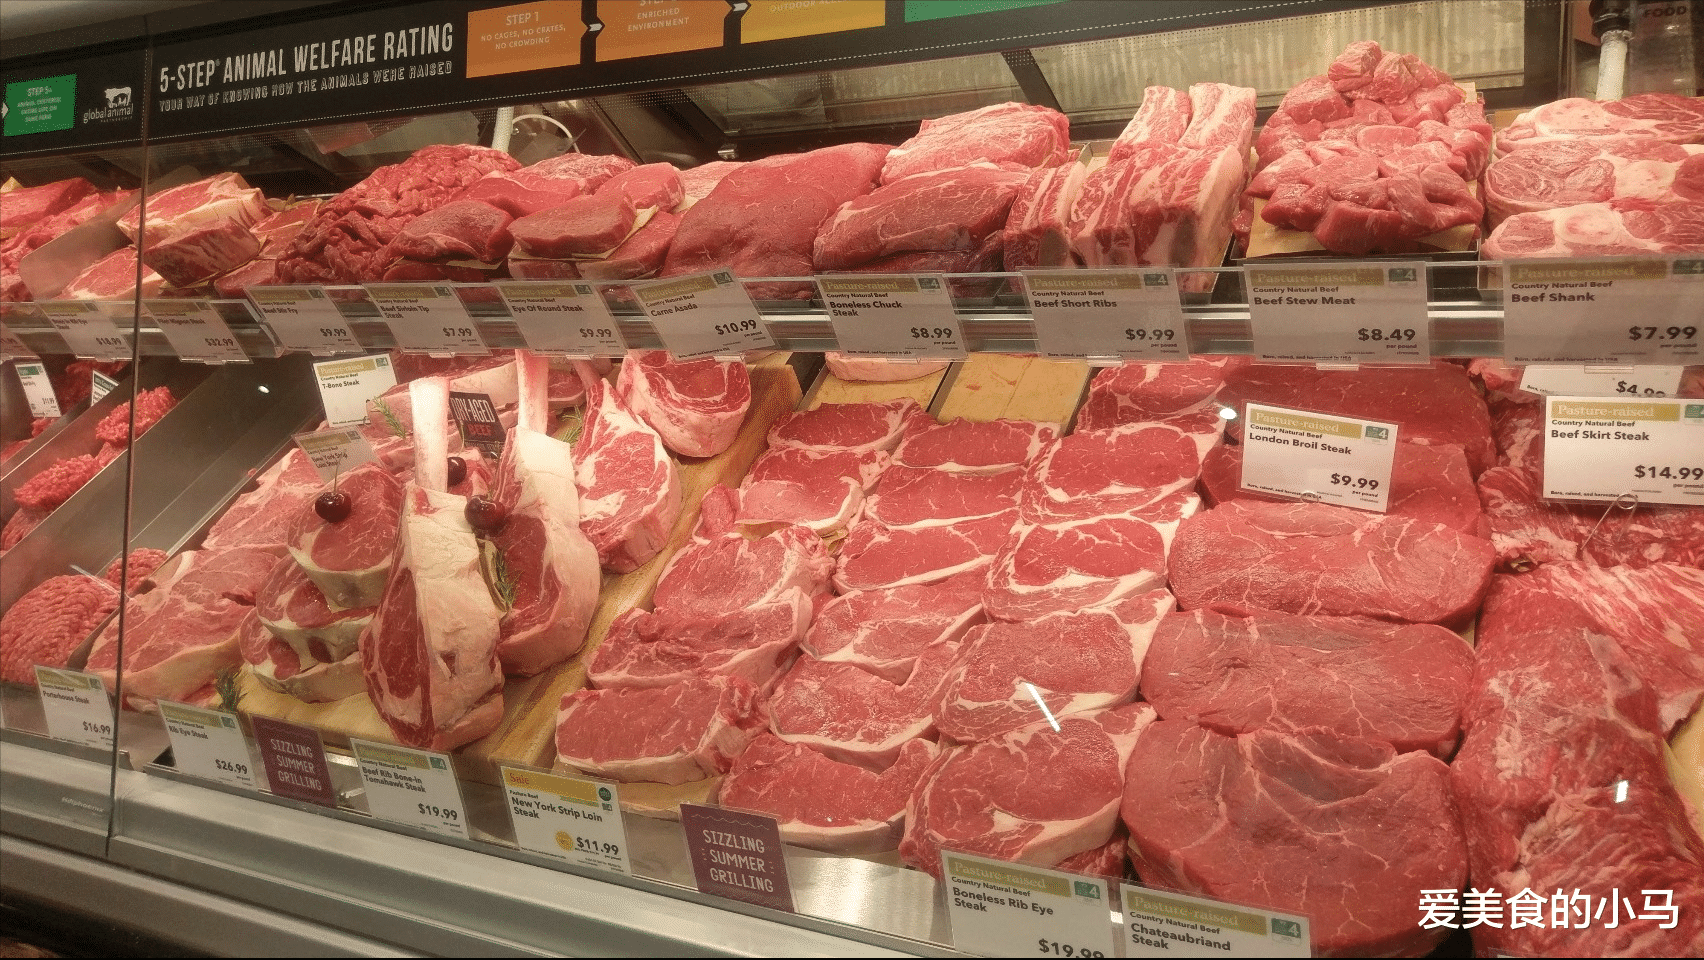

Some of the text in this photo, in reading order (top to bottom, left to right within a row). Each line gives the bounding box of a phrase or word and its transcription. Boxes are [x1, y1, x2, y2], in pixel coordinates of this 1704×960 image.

[506, 11, 539, 26] STEP 1
[637, 7, 680, 20] ENRICHED
[627, 16, 690, 32] ENVIRONMENT
[481, 24, 566, 42] NO CAGES, NO CRATES,
[495, 36, 550, 50] NO CROWDING
[223, 48, 287, 84] ANIMAL
[294, 33, 377, 73] WELFARE
[383, 22, 454, 61] RATING
[159, 60, 453, 112] YOUR WAY OF KNOWING HOW THE ANIMALS WERE RAISED
[83, 103, 134, 124] global animal
[1257, 272, 1357, 284] Pasture-raised
[1518, 267, 1635, 279] Pasture-raised
[826, 281, 900, 290] Pasture-raised
[1032, 278, 1118, 288] Pasture-raised
[1253, 286, 1285, 294] Country
[1511, 282, 1549, 290] Country
[1551, 281, 1588, 289] Natural
[1032, 290, 1060, 298] Country
[1254, 296, 1356, 305] Beef Stew Meat
[1511, 292, 1595, 303] Beef Shank
[512, 305, 525, 314] Eye
[650, 302, 698, 317] Carne Asada
[829, 300, 903, 309] Boneless Chuck
[1034, 299, 1118, 308] Beef Short Ribs
[832, 309, 859, 317] Steak
[320, 328, 347, 337] $9.99
[443, 327, 472, 337] $7.99
[579, 328, 612, 338] $9.99
[715, 319, 757, 336] $10.99
[910, 326, 953, 339] $8.99
[1125, 328, 1175, 341] $9.99
[1357, 327, 1416, 342] $8.49
[1628, 325, 1697, 341] $7.99
[204, 338, 234, 347] $32.99
[450, 397, 496, 423] DRY-AGED
[1558, 404, 1655, 417] Pasture-raised
[467, 423, 492, 436] BEEF
[1255, 412, 1339, 433] Pasture-raised
[1551, 419, 1583, 428] Country
[1250, 424, 1277, 434] Country
[1279, 428, 1305, 437] Natural
[1551, 429, 1650, 441] Beef Skirt Steak
[1249, 432, 1352, 455] London Broil Steak
[1634, 464, 1704, 481] $14.99
[1330, 472, 1379, 490] $9.99
[43, 690, 89, 704] Porterhouse Steak
[82, 720, 111, 735] $16.99
[168, 725, 209, 740] Rib Eye Steak
[270, 738, 313, 758] SIZZLING
[215, 758, 248, 775] $26.99
[276, 754, 315, 774] SUMMER
[362, 766, 379, 776] Beef
[379, 769, 393, 779] Rib
[509, 772, 530, 785] Sale
[278, 770, 322, 791] GRILLING
[364, 774, 426, 793] Tomahawk Steak
[418, 802, 458, 821] $19.99
[511, 796, 603, 822] New York Strip Loin
[513, 806, 540, 819] Steak
[576, 836, 619, 856] $11.99
[702, 829, 765, 854] SIZZLING
[709, 848, 767, 873] SUMMER
[709, 867, 774, 893] GRILLING
[954, 861, 1047, 889] Pasture-raised
[951, 876, 1031, 897] Country Natural Beef
[1088, 886, 1099, 898] 4
[952, 886, 1054, 916] Boneless Rib Eye
[954, 897, 988, 913] Steak
[1134, 896, 1239, 926] Pasture-raised
[1129, 911, 1220, 935] Country Natural Beef
[1290, 923, 1299, 937] 4
[1131, 922, 1232, 951] Chateaubriand
[1131, 933, 1169, 950] Steak
[1038, 938, 1105, 959] $19.99
